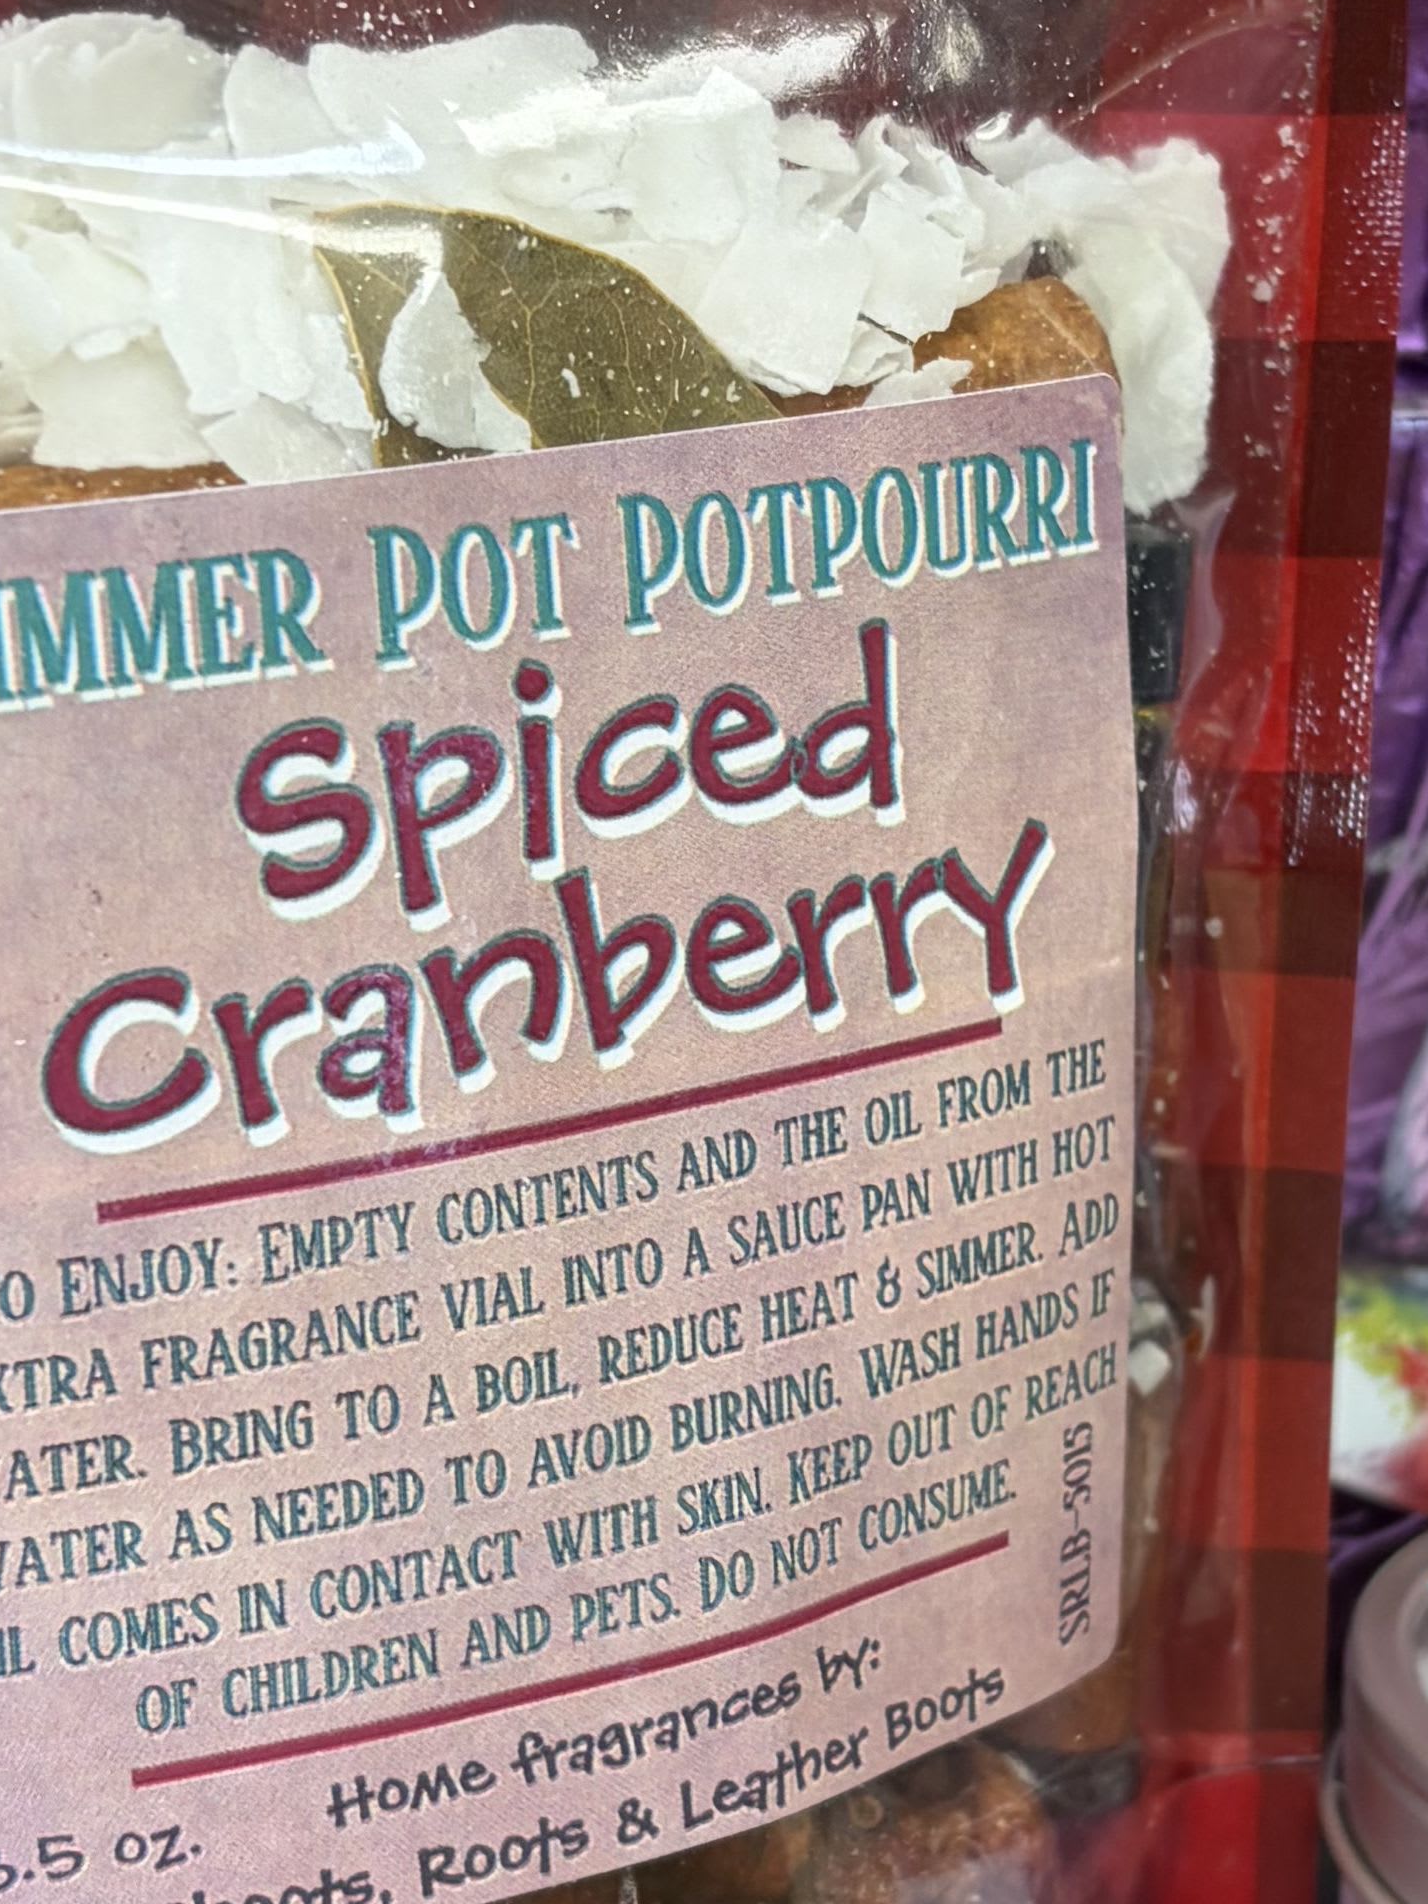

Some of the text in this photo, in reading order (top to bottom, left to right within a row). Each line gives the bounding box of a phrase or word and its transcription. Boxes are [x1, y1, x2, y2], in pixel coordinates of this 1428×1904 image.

[370, 514, 575, 665] POT
[622, 439, 1100, 631] POTPOURRI
[235, 616, 904, 929] Spiced
[40, 819, 1053, 1154] Cranberry
[57, 1239, 238, 1318] ENJOY:
[258, 1203, 414, 1284] EMPTY
[437, 1152, 658, 1244] CONTENTS
[677, 1130, 756, 1192] AND
[775, 1108, 847, 1168] THE
[866, 1091, 921, 1145] OIL
[938, 1061, 1029, 1127] FROM
[1047, 1040, 1105, 1096] THE
[141, 1292, 420, 1389] FRAGRANCE
[441, 1268, 544, 1331] VIAL
[562, 1239, 662, 1306] INTO
[684, 1228, 713, 1278] A
[728, 1193, 845, 1267] SAUCE
[861, 1170, 930, 1231] PAN
[947, 1141, 1037, 1205] WITH
[1053, 1116, 1115, 1176] HOT
[169, 1401, 313, 1476] BRING
[336, 1385, 399, 1440] TO
[424, 1375, 455, 1425] A
[474, 1349, 580, 1413] BOIL,
[598, 1304, 743, 1384] REDUCE
[760, 1272, 858, 1343] HEAT
[877, 1257, 900, 1308] &
[917, 1224, 1042, 1298] SIMMER.
[1059, 1194, 1118, 1257] ADD
[169, 1503, 231, 1561] AS
[252, 1469, 424, 1545] NEEDED
[445, 1450, 505, 1505] TO
[528, 1416, 650, 1488] AVOID
[669, 1364, 841, 1451] BURNING.
[859, 1324, 960, 1398] WASH
[977, 1284, 1078, 1359] HANDS
[1091, 1269, 1114, 1318] IF
[59, 1592, 218, 1665] COMES
[238, 1580, 287, 1635] IN
[311, 1531, 522, 1619] CONTACT
[543, 1496, 658, 1566] WITH
[678, 1467, 771, 1535] SKIN.
[788, 1436, 871, 1505] KEEP
[889, 1405, 956, 1465] OUT
[972, 1386, 1010, 1437] OF
[1026, 1343, 1115, 1420] REACH
[136, 1460, 1016, 1734] OF CHILDREN AND PETS. DO NOT CONSUME.
[115, 1826, 201, 1871] oz.
[418, 1819, 588, 1897] Roots
[618, 1799, 658, 1843] &
[681, 1729, 867, 1828] Leather
[886, 1670, 1003, 1749] Boots
[511, 1673, 800, 1786] fragrances
[816, 1639, 879, 1693] by:
